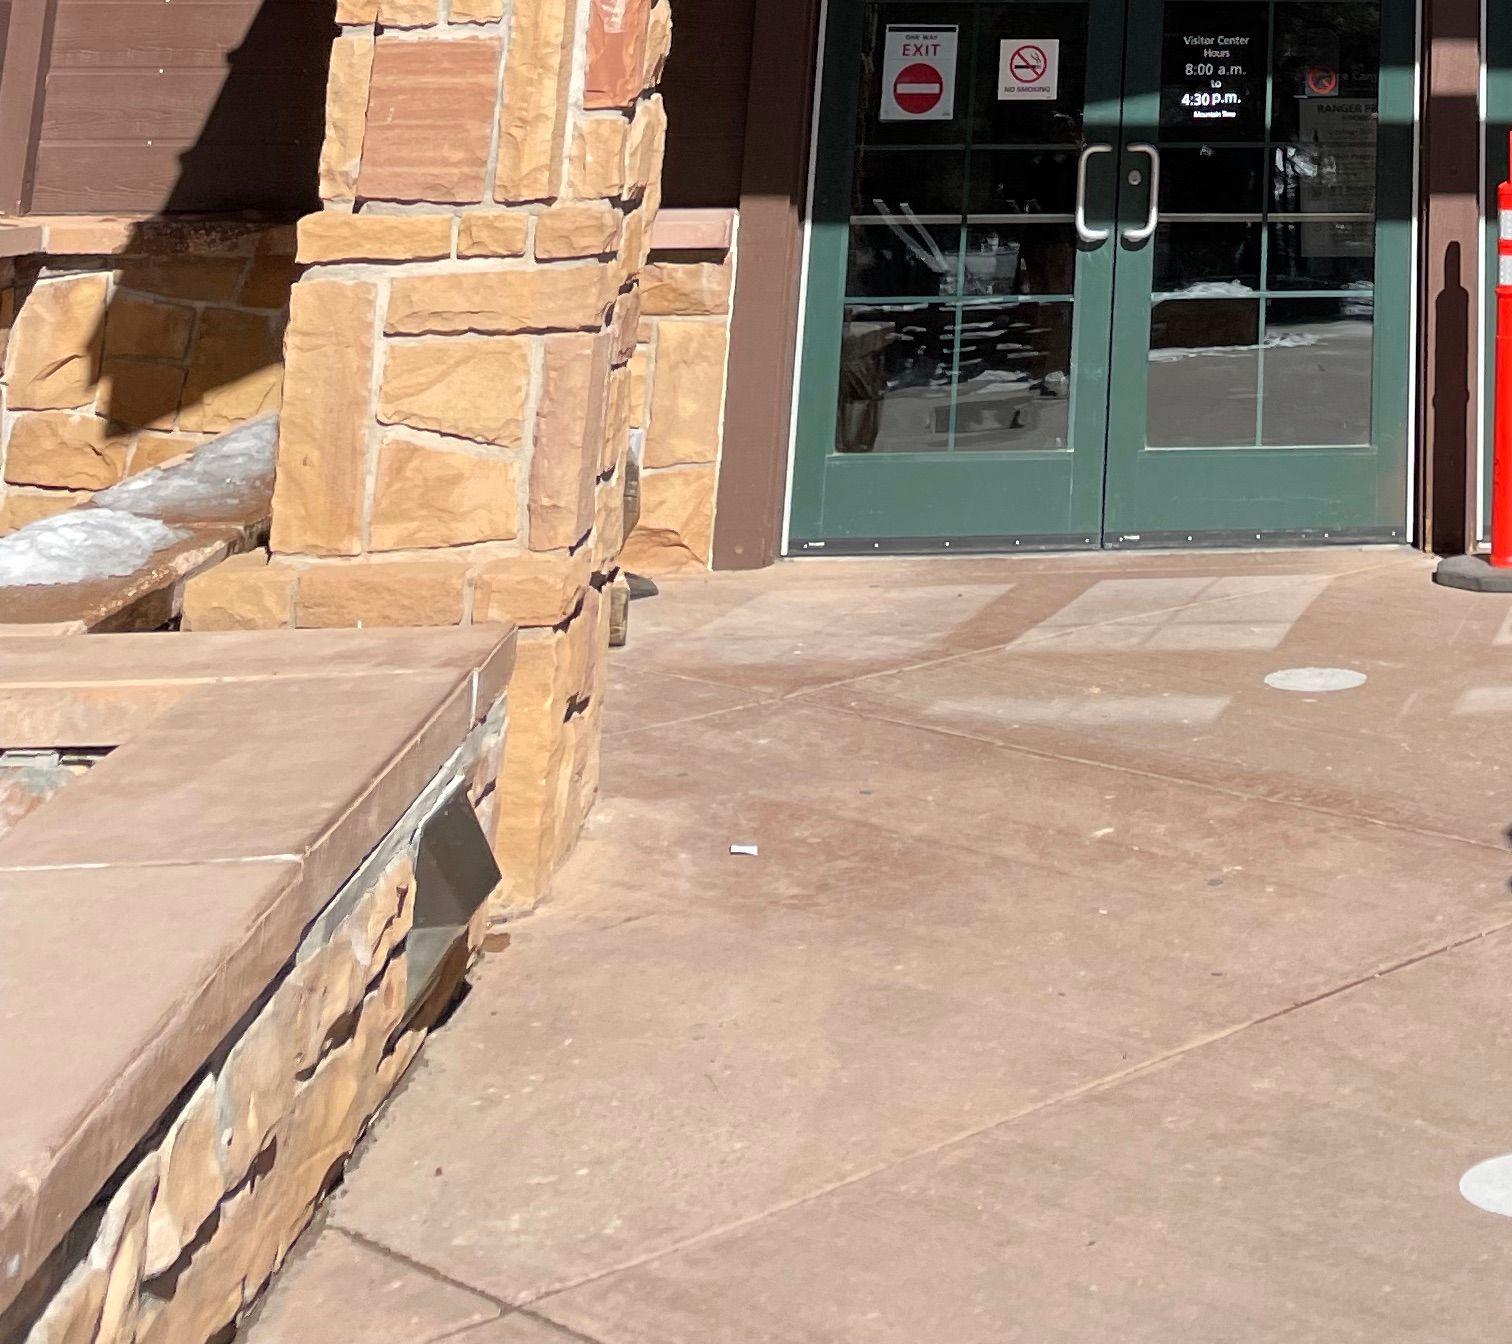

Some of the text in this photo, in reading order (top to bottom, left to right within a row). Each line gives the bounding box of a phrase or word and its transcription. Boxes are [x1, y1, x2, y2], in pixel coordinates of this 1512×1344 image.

[1183, 35, 1250, 45] Visitor Center
[902, 43, 941, 57] EXIT
[1203, 48, 1231, 58] Hours
[1185, 63, 1247, 75] 8:00 a.m.
[1210, 79, 1222, 88] to
[1181, 93, 1242, 106] 4:30 p.m.
[1317, 104, 1362, 113] RANGER
